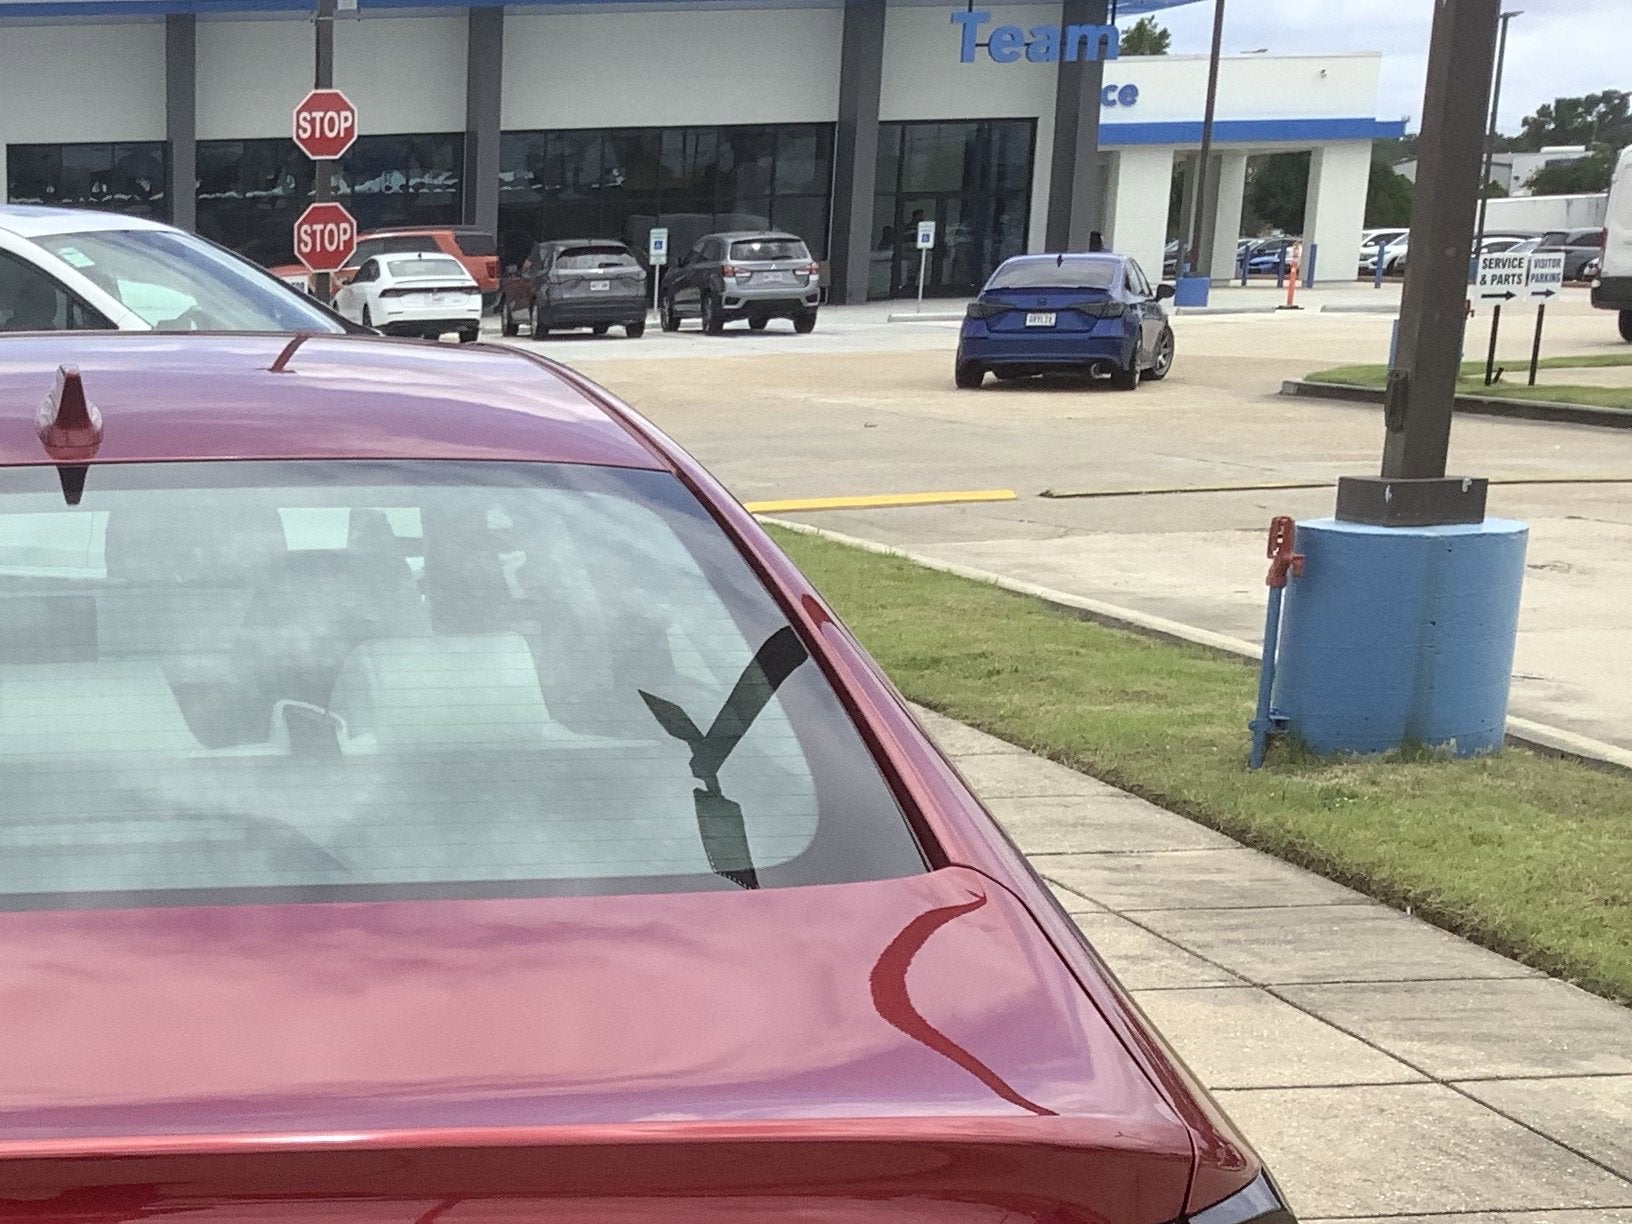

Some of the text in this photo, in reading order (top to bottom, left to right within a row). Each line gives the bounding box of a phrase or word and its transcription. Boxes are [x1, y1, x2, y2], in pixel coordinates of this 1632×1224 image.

[951, 11, 1120, 63] Team
[298, 110, 353, 139] STOP
[299, 222, 351, 253] STOP
[1482, 257, 1525, 269] SERVICE
[1479, 273, 1524, 286] & PARTS
